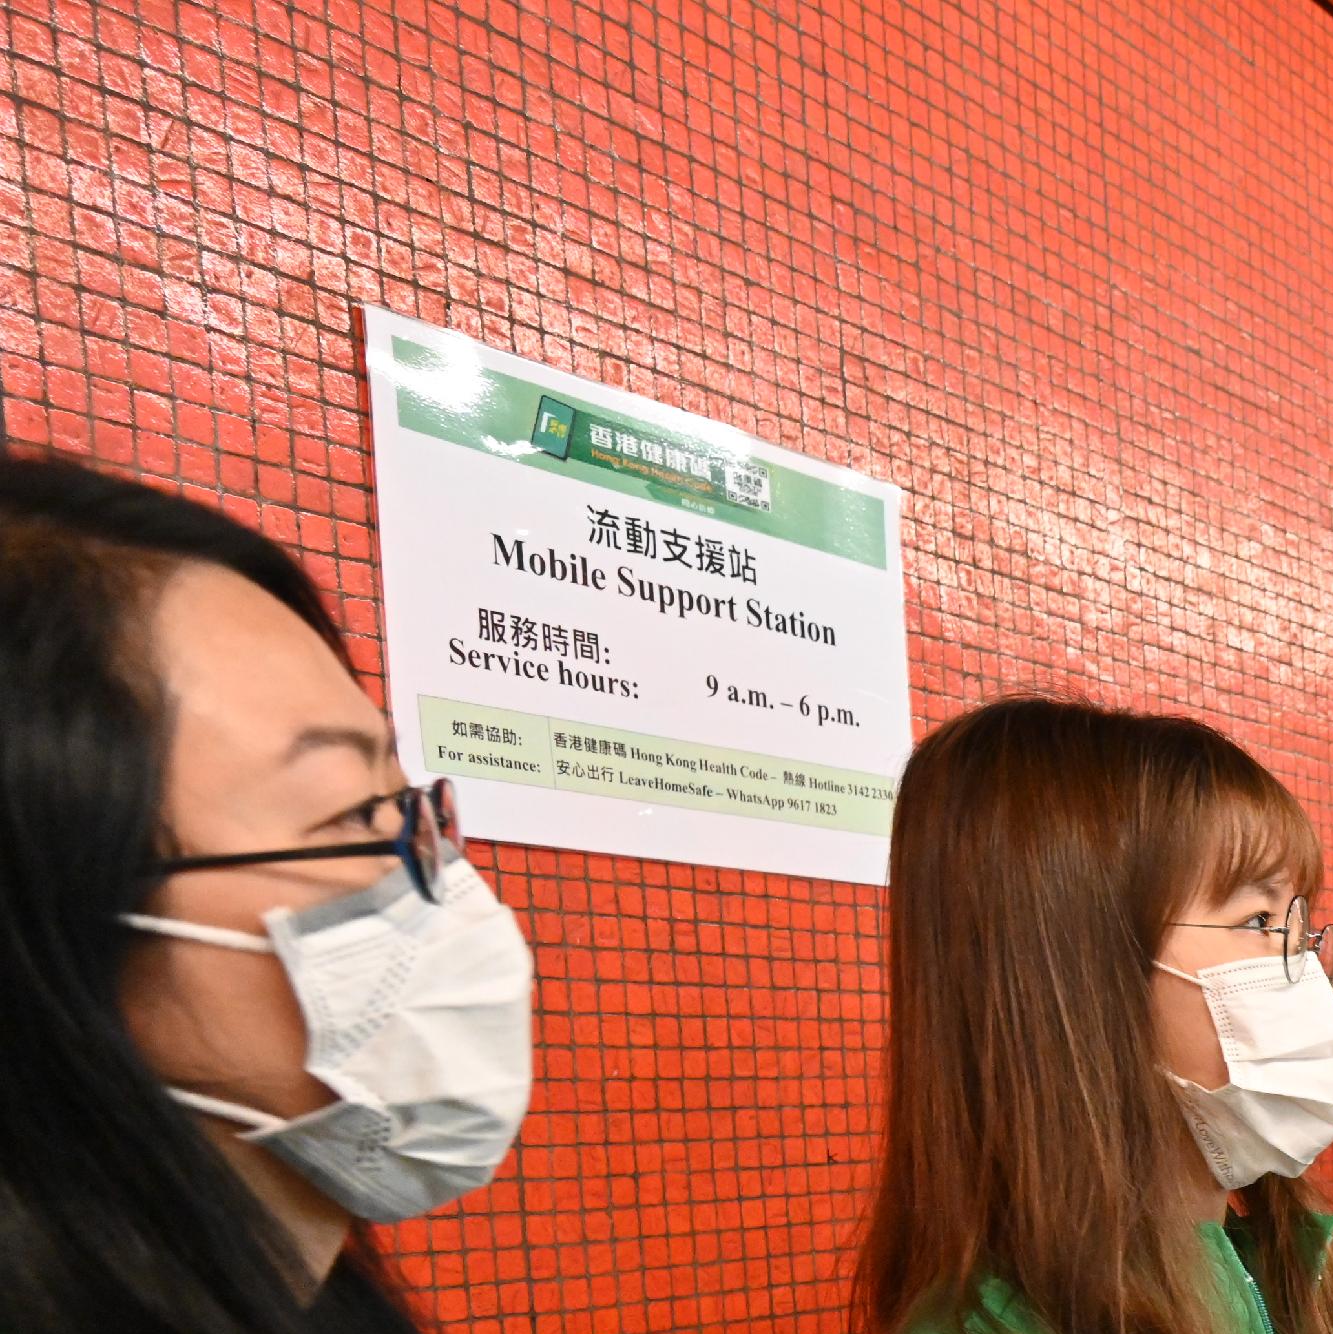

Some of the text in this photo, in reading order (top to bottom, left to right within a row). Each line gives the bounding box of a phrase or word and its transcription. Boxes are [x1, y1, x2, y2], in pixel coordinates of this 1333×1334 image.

[589, 422, 712, 481] 香港健康碼
[591, 449, 621, 465] Hong
[586, 504, 757, 586] 流動支援站
[490, 533, 837, 646] Mobile Support Station
[478, 607, 610, 665] 服務時間:
[448, 637, 640, 699] Service hours:
[706, 674, 719, 698] 9
[727, 684, 774, 710] a.m.
[799, 694, 810, 717] 6
[817, 703, 860, 727] p.m.
[438, 745, 541, 773] For assistance:
[452, 719, 522, 746] 如需協助:
[553, 732, 627, 759] 香港健康碼
[630, 746, 662, 768] Hong
[666, 752, 697, 773] Kong
[700, 758, 737, 777] Health
[740, 765, 768, 782] Code
[783, 770, 806, 789] 熱線
[809, 777, 845, 795] Hotline
[848, 783, 870, 799] 3142
[556, 759, 615, 784] 安心出行
[619, 771, 714, 798] LeaveHomeSafe
[726, 788, 785, 811] WhatsApp
[787, 798, 811, 814] 9617
[815, 801, 838, 817] 1823
